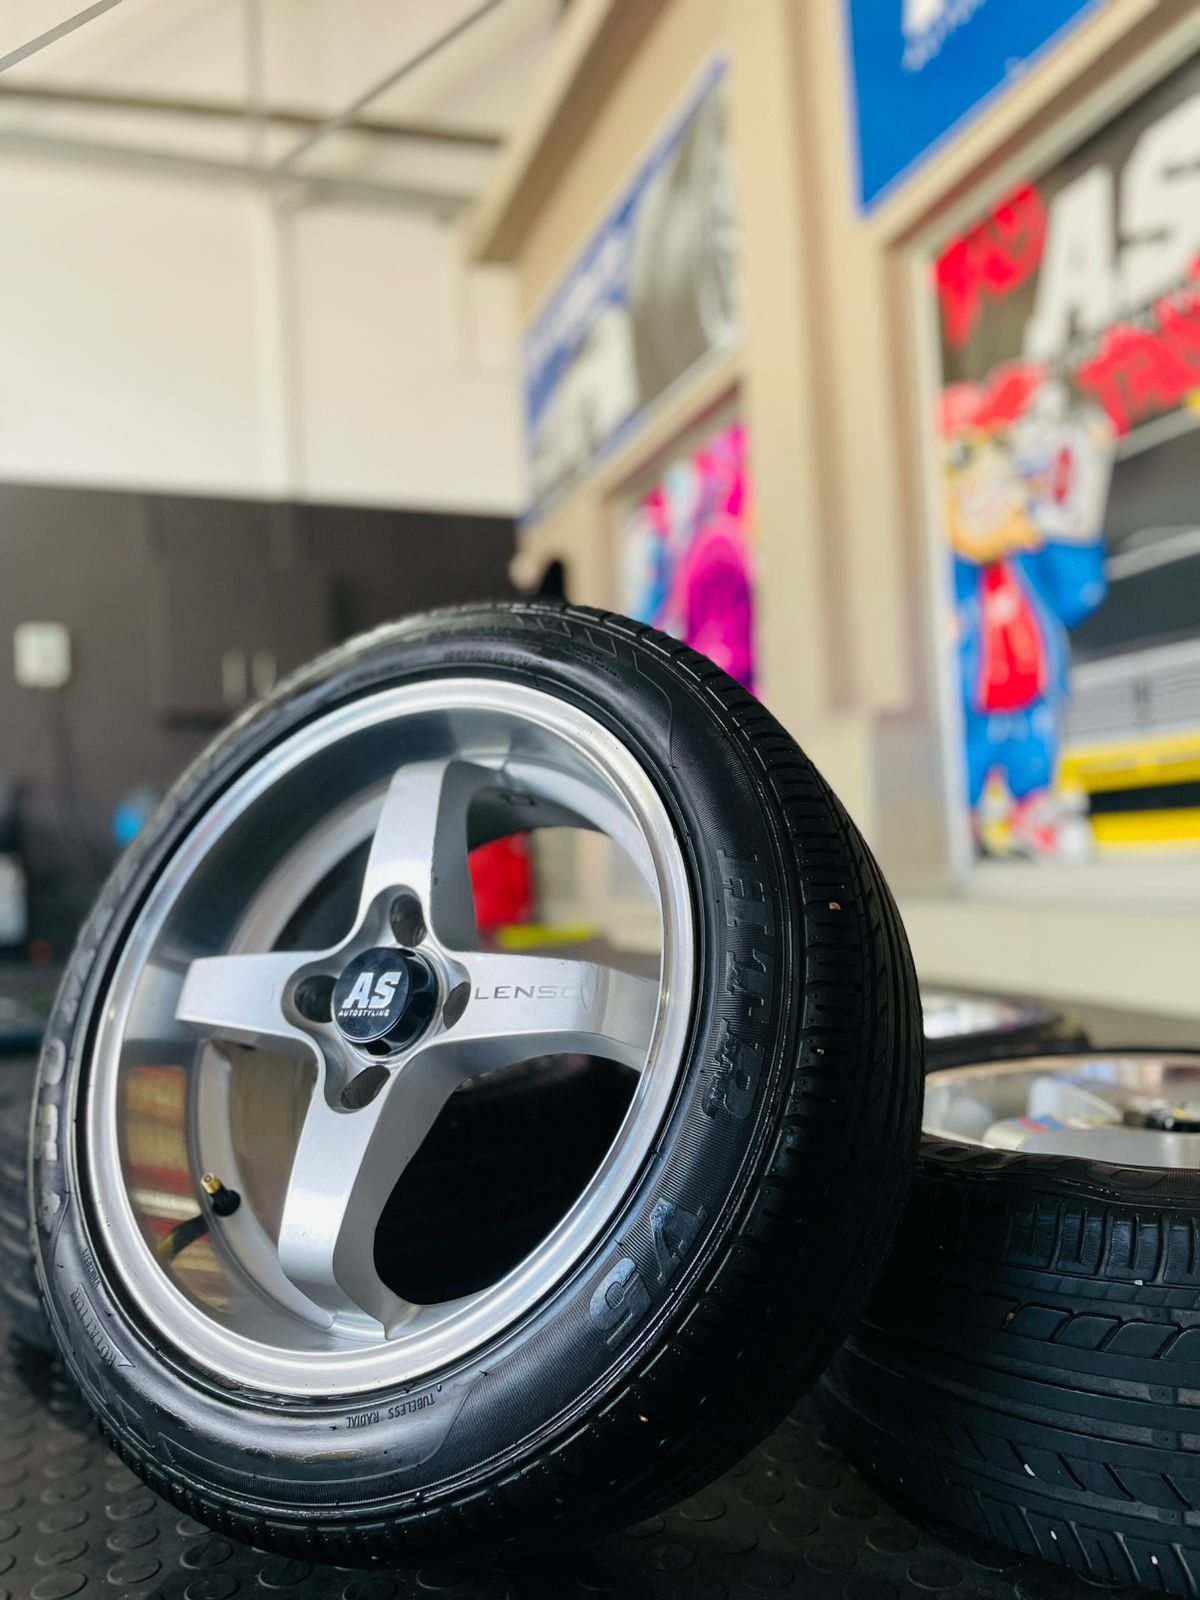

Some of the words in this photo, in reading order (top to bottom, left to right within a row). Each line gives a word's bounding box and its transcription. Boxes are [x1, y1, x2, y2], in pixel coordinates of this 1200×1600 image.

[342, 972, 402, 1008] AS
[338, 1009, 391, 1018] AUTOSTYLING
[70, 1287, 117, 1367] ROTATION
[346, 1410, 380, 1427] RADIAL
[387, 1392, 436, 1420] TUBELESS
